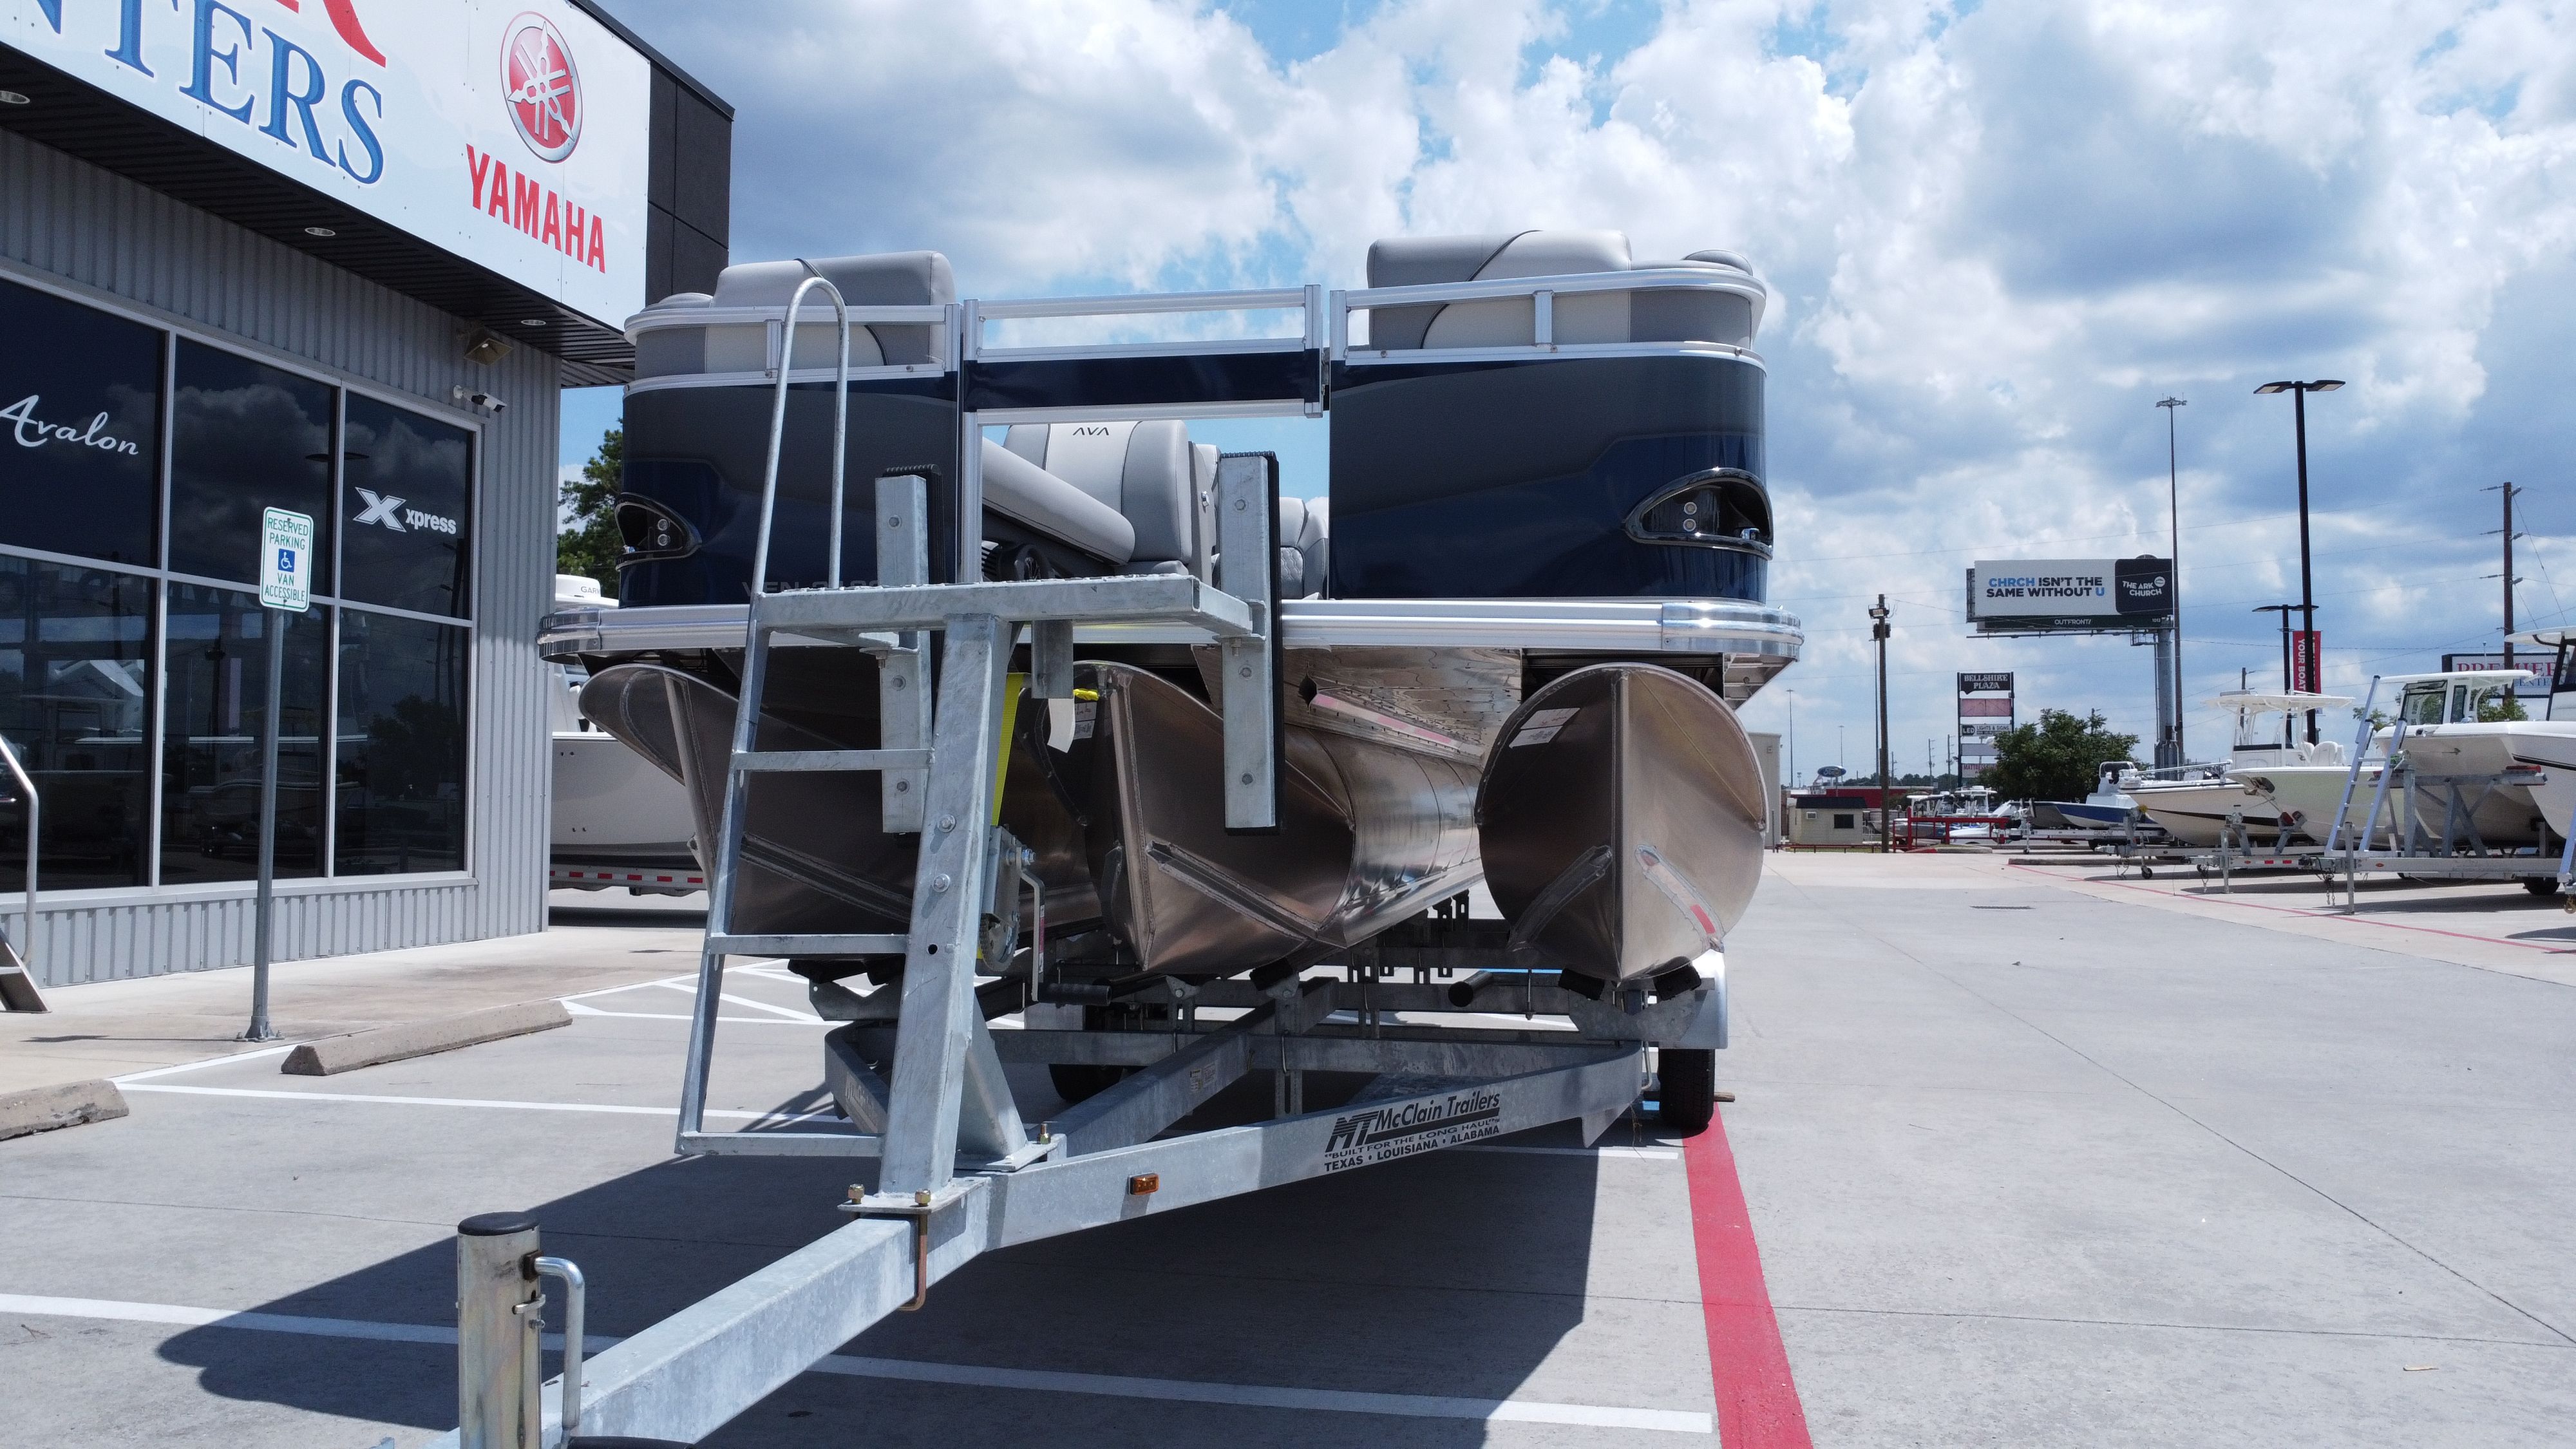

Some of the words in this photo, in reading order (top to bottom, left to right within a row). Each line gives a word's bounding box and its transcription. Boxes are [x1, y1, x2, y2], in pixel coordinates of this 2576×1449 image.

[466, 144, 606, 274] YAMAHA
[0, 395, 138, 455] Avalon
[1072, 427, 1110, 436] AVA
[267, 517, 308, 536] RESERVED
[405, 508, 457, 535] xpress
[269, 532, 305, 550] PARKING
[278, 573, 294, 587] VAN
[1988, 577, 2036, 587] CHRCH
[2038, 577, 2072, 587] ISN'T
[2074, 576, 2103, 586] THE
[2122, 580, 2137, 589] THE
[264, 585, 305, 602] ACCESSIBLE
[1986, 587, 2024, 598] SAME
[2027, 587, 2092, 598] WITHOUT
[2096, 587, 2105, 597] U
[2129, 588, 2163, 596] CHURCH
[2298, 666, 2306, 690] BOAT
[1325, 1110, 1379, 1153] MT
[1374, 1100, 1442, 1132] McClain
[1447, 1090, 1500, 1116] Trailers
[1367, 1141, 1390, 1151] FOR
[1394, 1135, 1414, 1145] THE
[1419, 1127, 1457, 1140] LONG
[1324, 1155, 1363, 1172] TEXAS
[1377, 1139, 1438, 1160] LOUISIANA
[1450, 1125, 1499, 1144] ALABAMA
